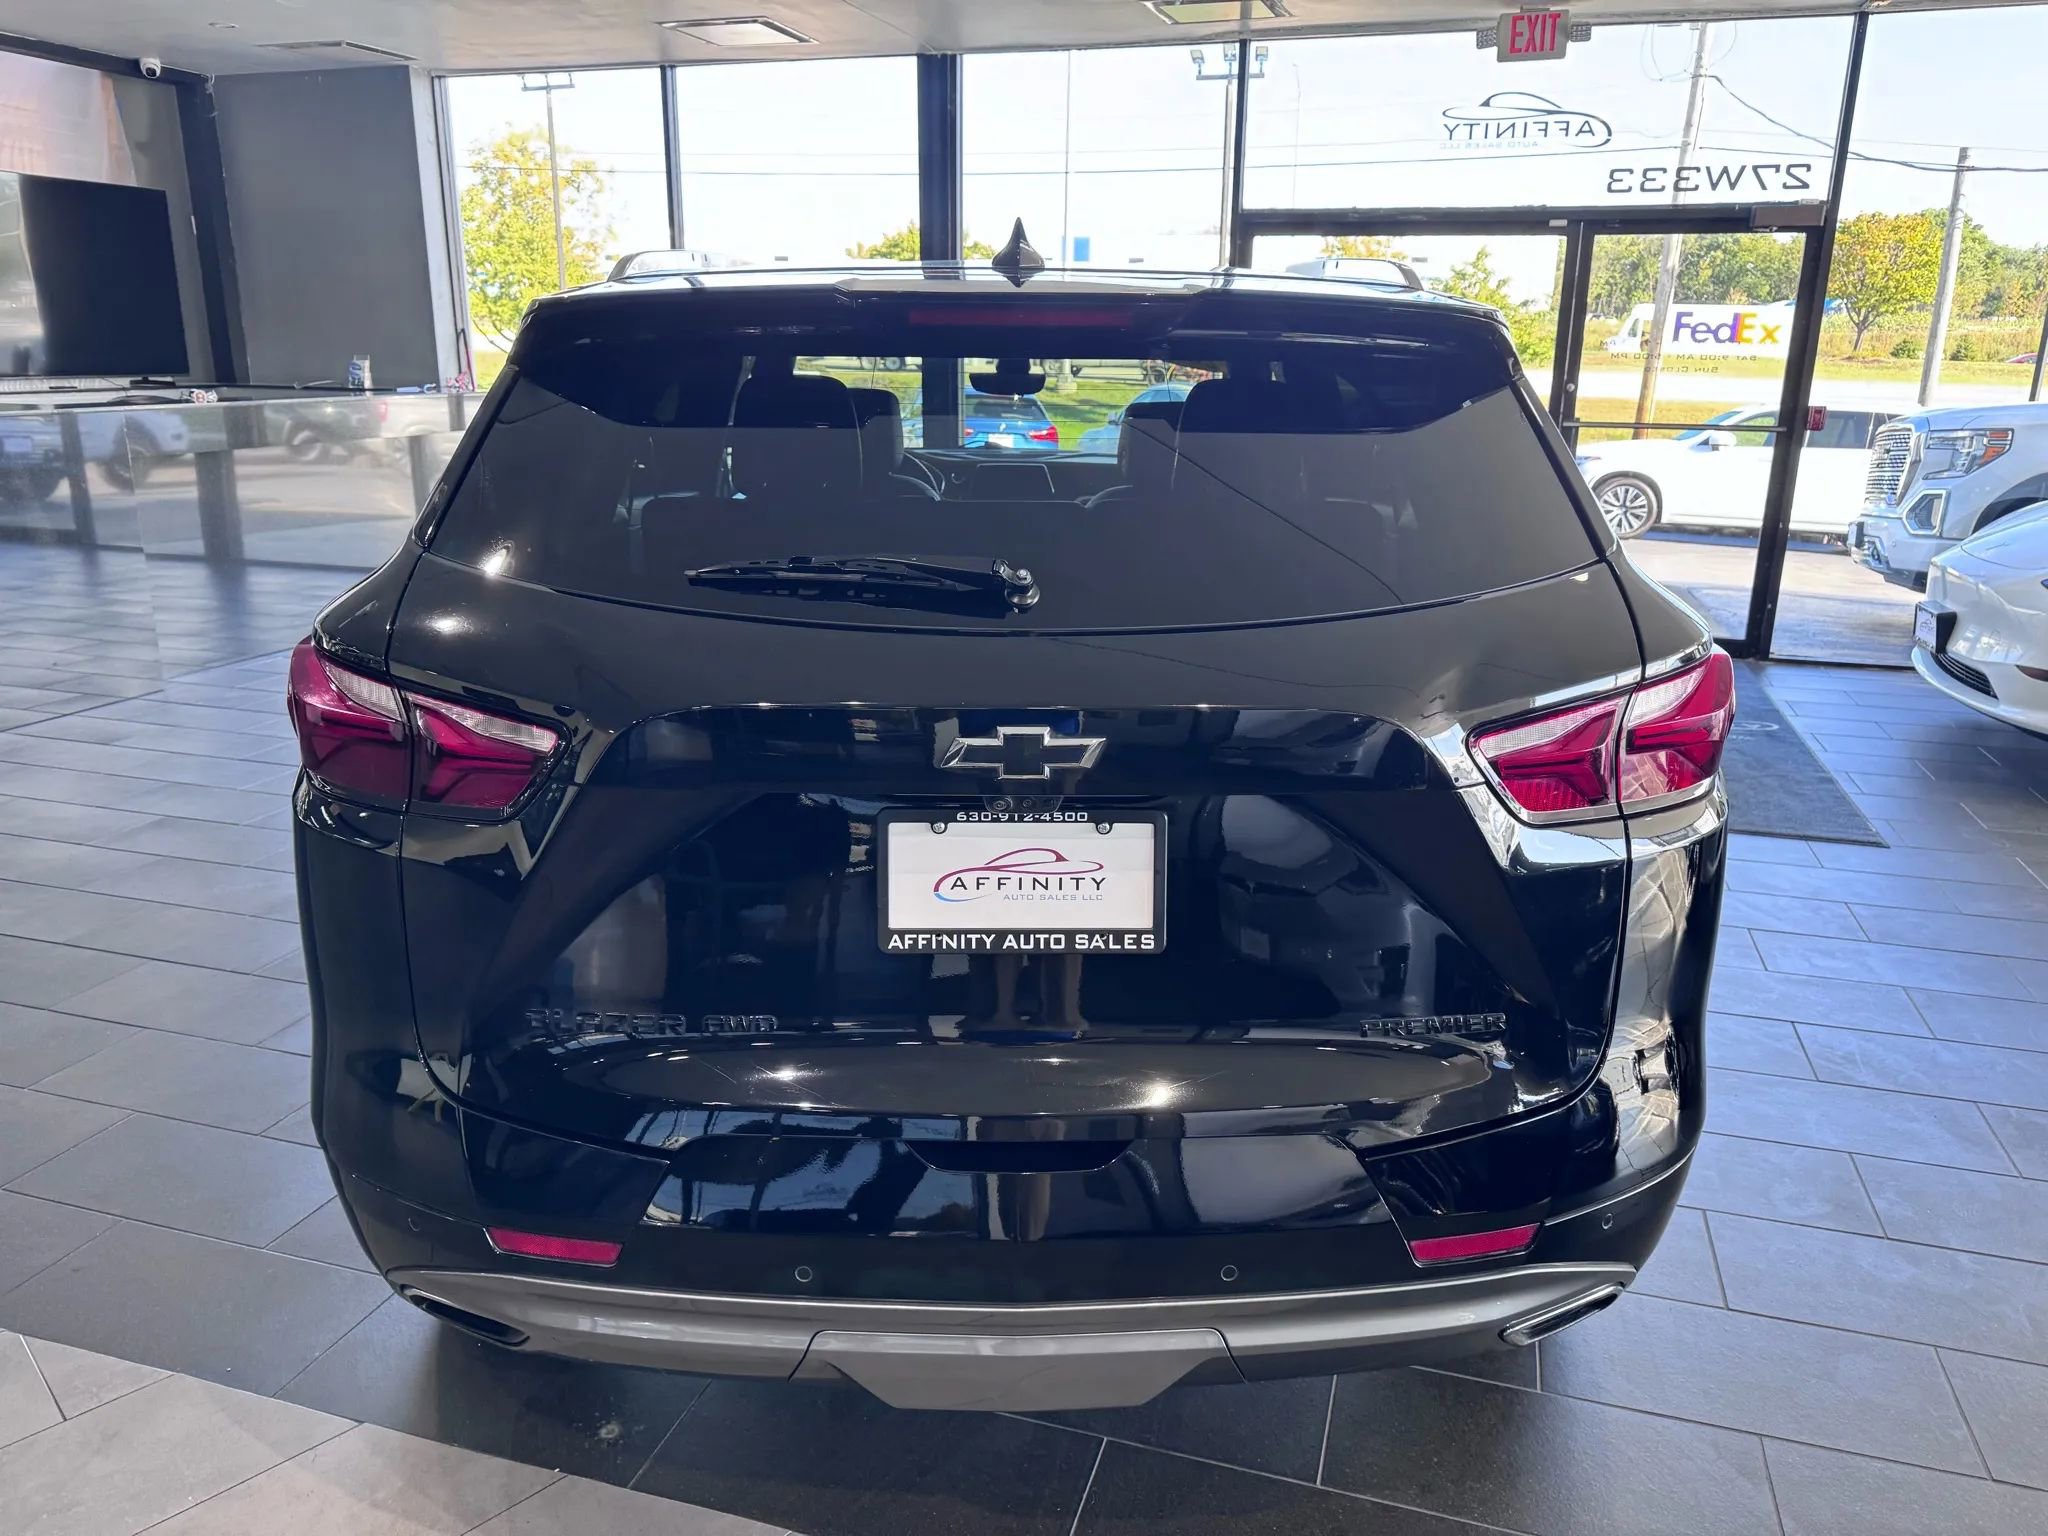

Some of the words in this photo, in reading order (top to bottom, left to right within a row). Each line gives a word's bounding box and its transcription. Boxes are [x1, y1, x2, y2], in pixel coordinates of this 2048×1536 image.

[1508, 13, 1562, 54] EXIT
[1672, 311, 1782, 344] FedEx
[956, 811, 1088, 822] 630-912-4500
[950, 876, 1106, 891] AFFINITY
[887, 933, 996, 950] AFFINITY
[1002, 933, 1066, 950] AUTO
[1074, 933, 1155, 950] SALES
[1360, 1012, 1507, 1037] PREMIER
